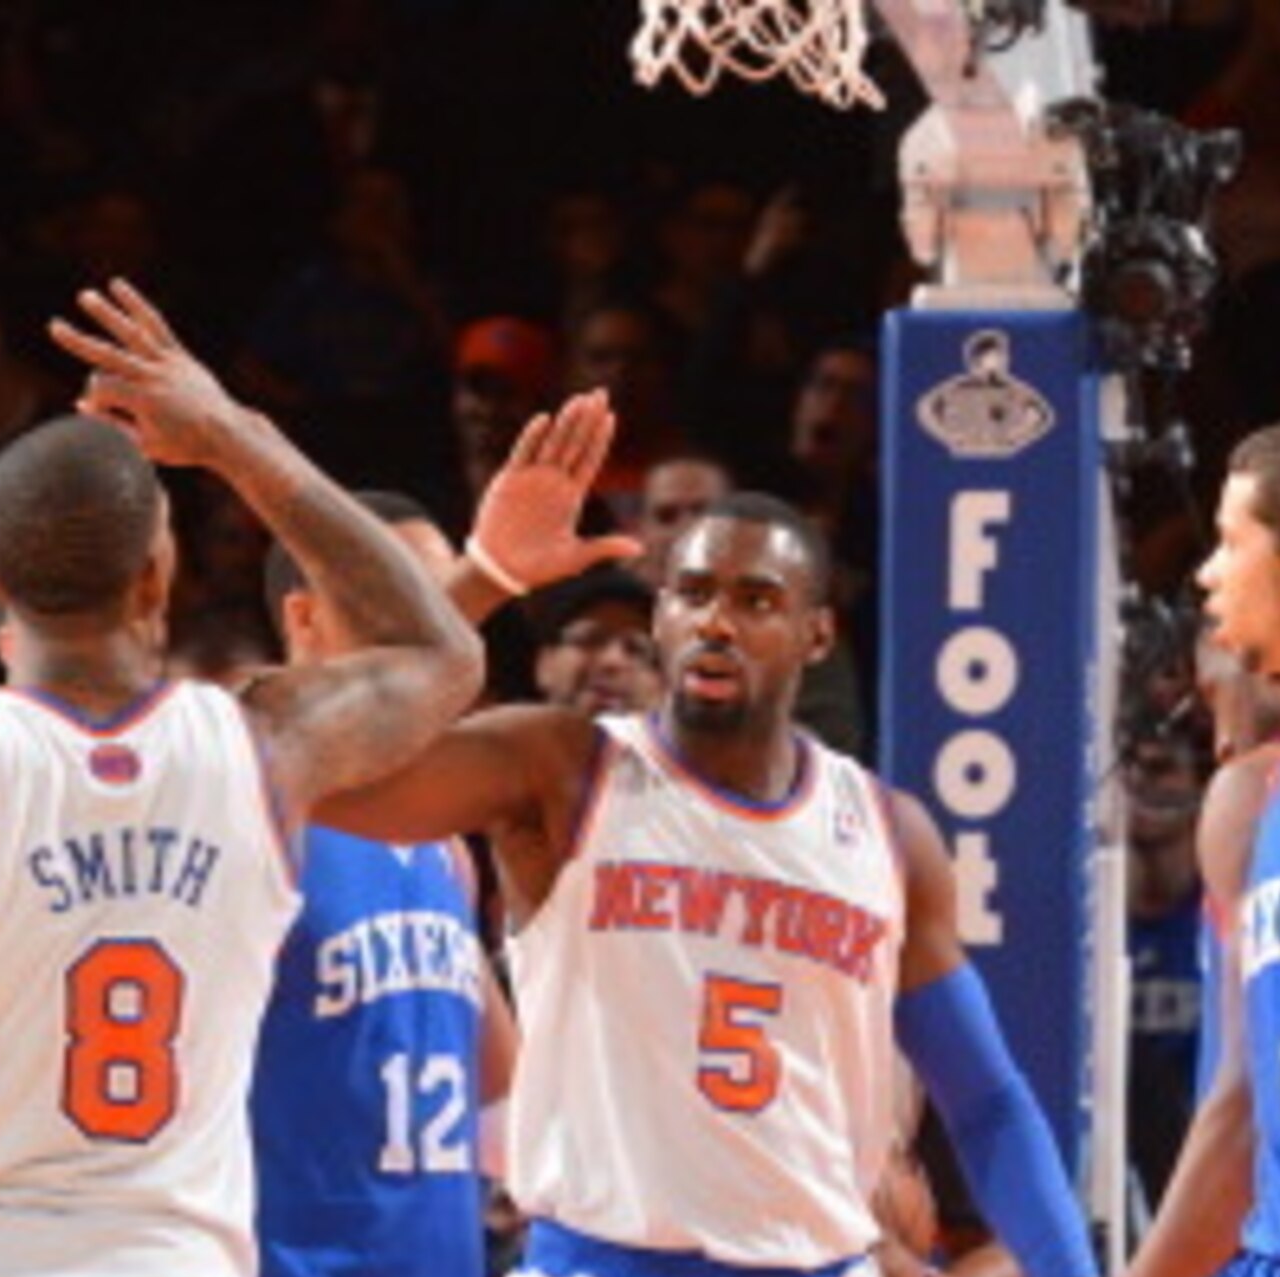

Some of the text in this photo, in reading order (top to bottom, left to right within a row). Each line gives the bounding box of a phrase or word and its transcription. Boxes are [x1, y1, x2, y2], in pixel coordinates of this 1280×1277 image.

[934, 489, 1018, 946] Foot
[29, 827, 219, 913] SMITH
[588, 860, 888, 987] NEW YORK
[59, 937, 186, 1145] 8
[696, 970, 783, 1117] 5
[378, 1052, 471, 1174] 12
